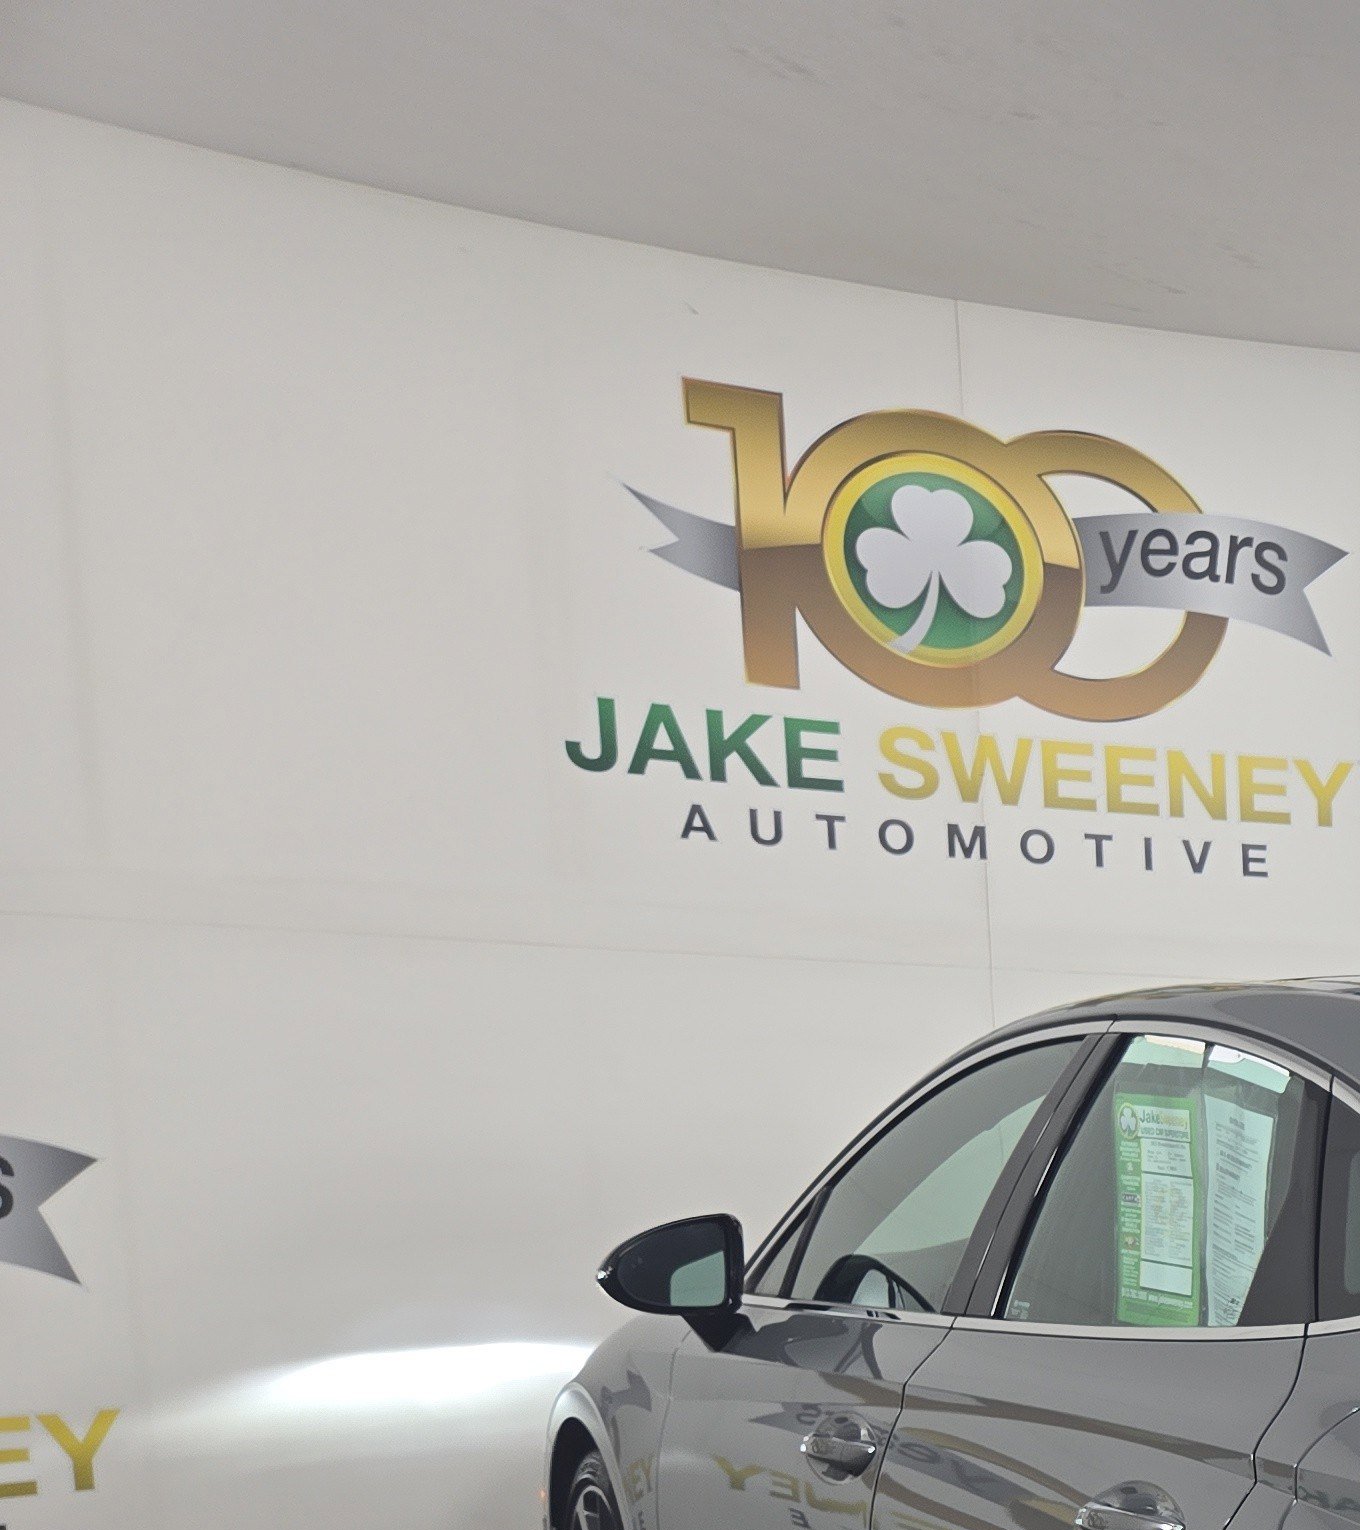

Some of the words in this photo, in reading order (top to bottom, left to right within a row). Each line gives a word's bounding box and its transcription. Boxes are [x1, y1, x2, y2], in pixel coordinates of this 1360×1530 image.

[1098, 525, 1288, 596] years
[565, 697, 846, 793] JAKE
[877, 725, 1355, 829] SWEENEY
[680, 804, 1270, 878] AUTOMOTIVE
